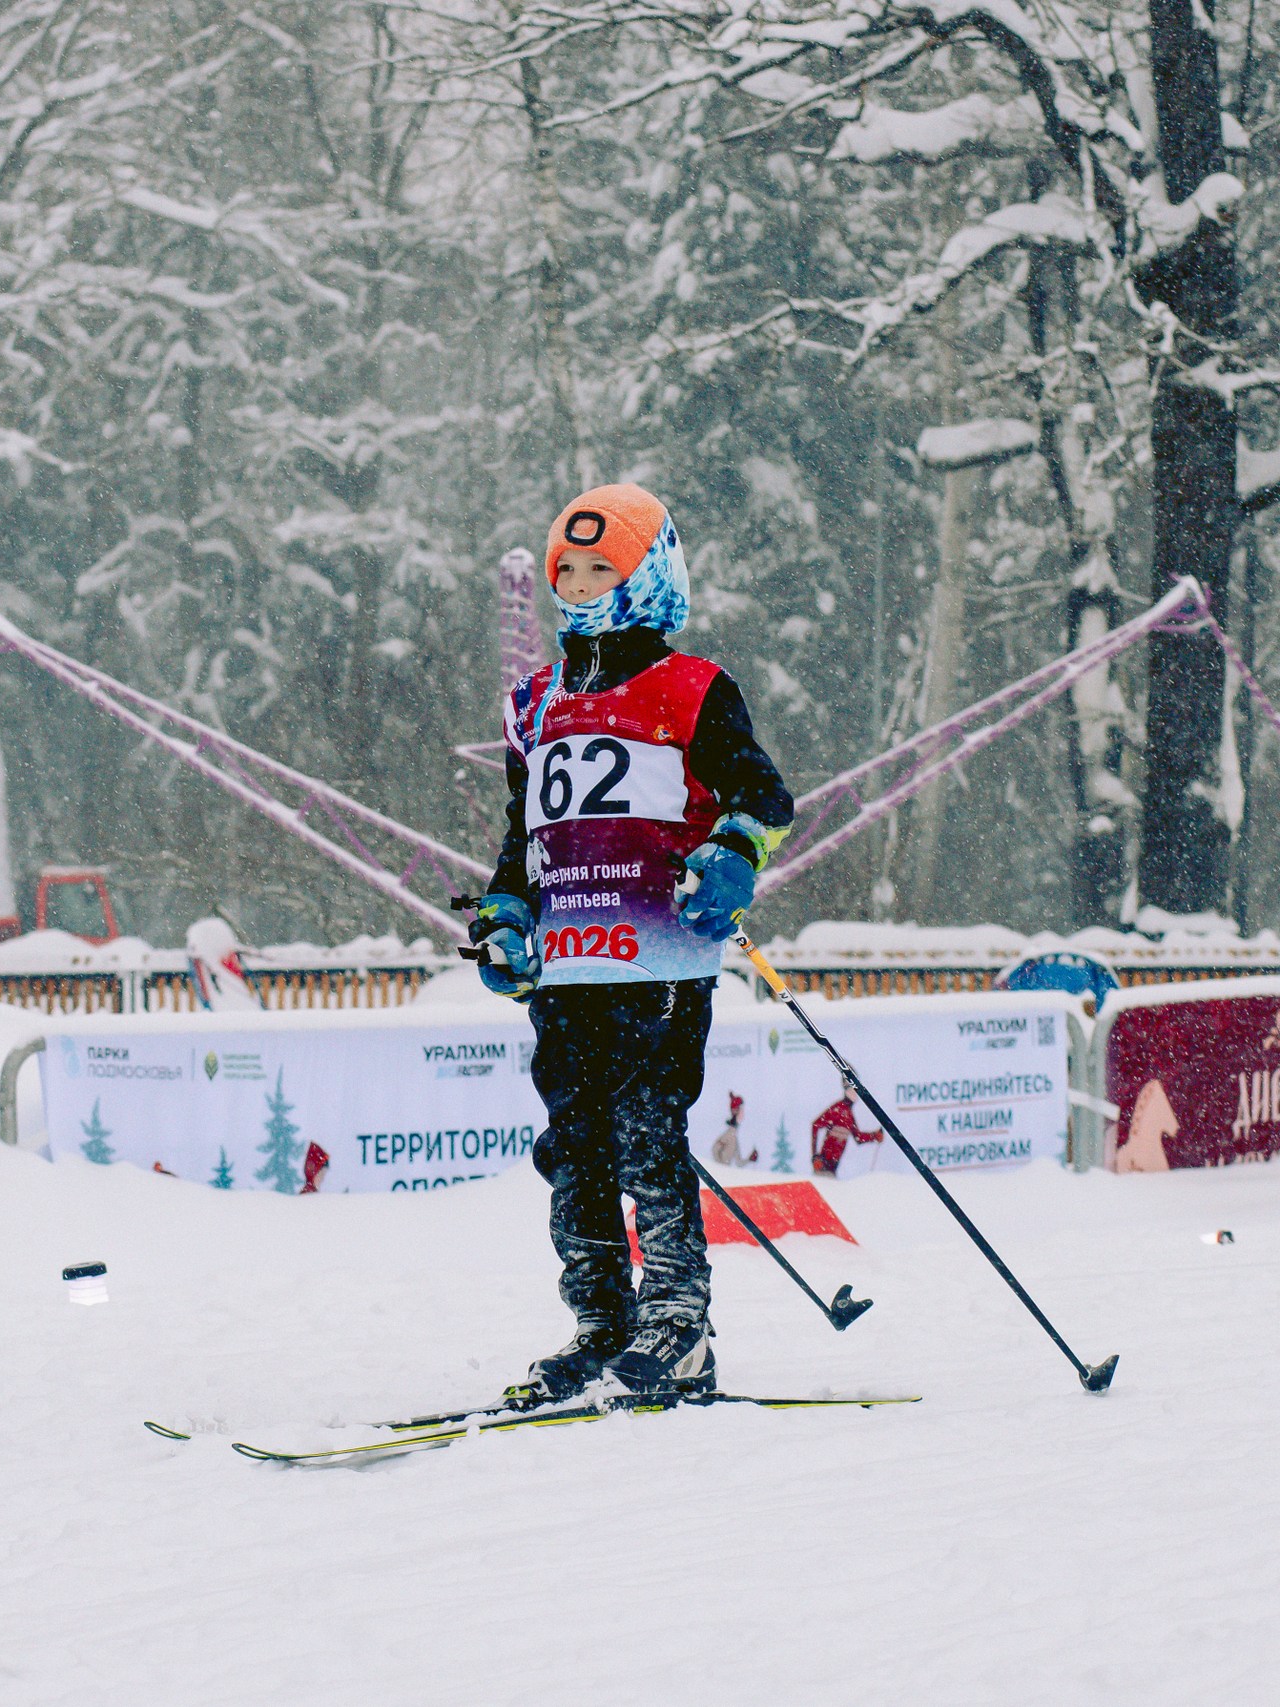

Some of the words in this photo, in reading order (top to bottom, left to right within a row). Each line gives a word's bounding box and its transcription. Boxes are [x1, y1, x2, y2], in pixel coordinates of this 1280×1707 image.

[539, 737, 631, 821] 62
[539, 866, 589, 888] Веерняя
[593, 863, 641, 880] гонка
[543, 923, 639, 963] 2026
[87, 1046, 130, 1060] ПАРКИ
[422, 1043, 506, 1061] УРАЛХИМ
[896, 1072, 1053, 1104] ПРИСОЕДИНЯЙТЕСЬ
[937, 1114, 947, 1132] К
[951, 1109, 1013, 1131] НАШИМ
[356, 1125, 534, 1165] ТЕРРИТОРИЯ
[918, 1139, 1032, 1166] ТРЕНИРОВКАМ
